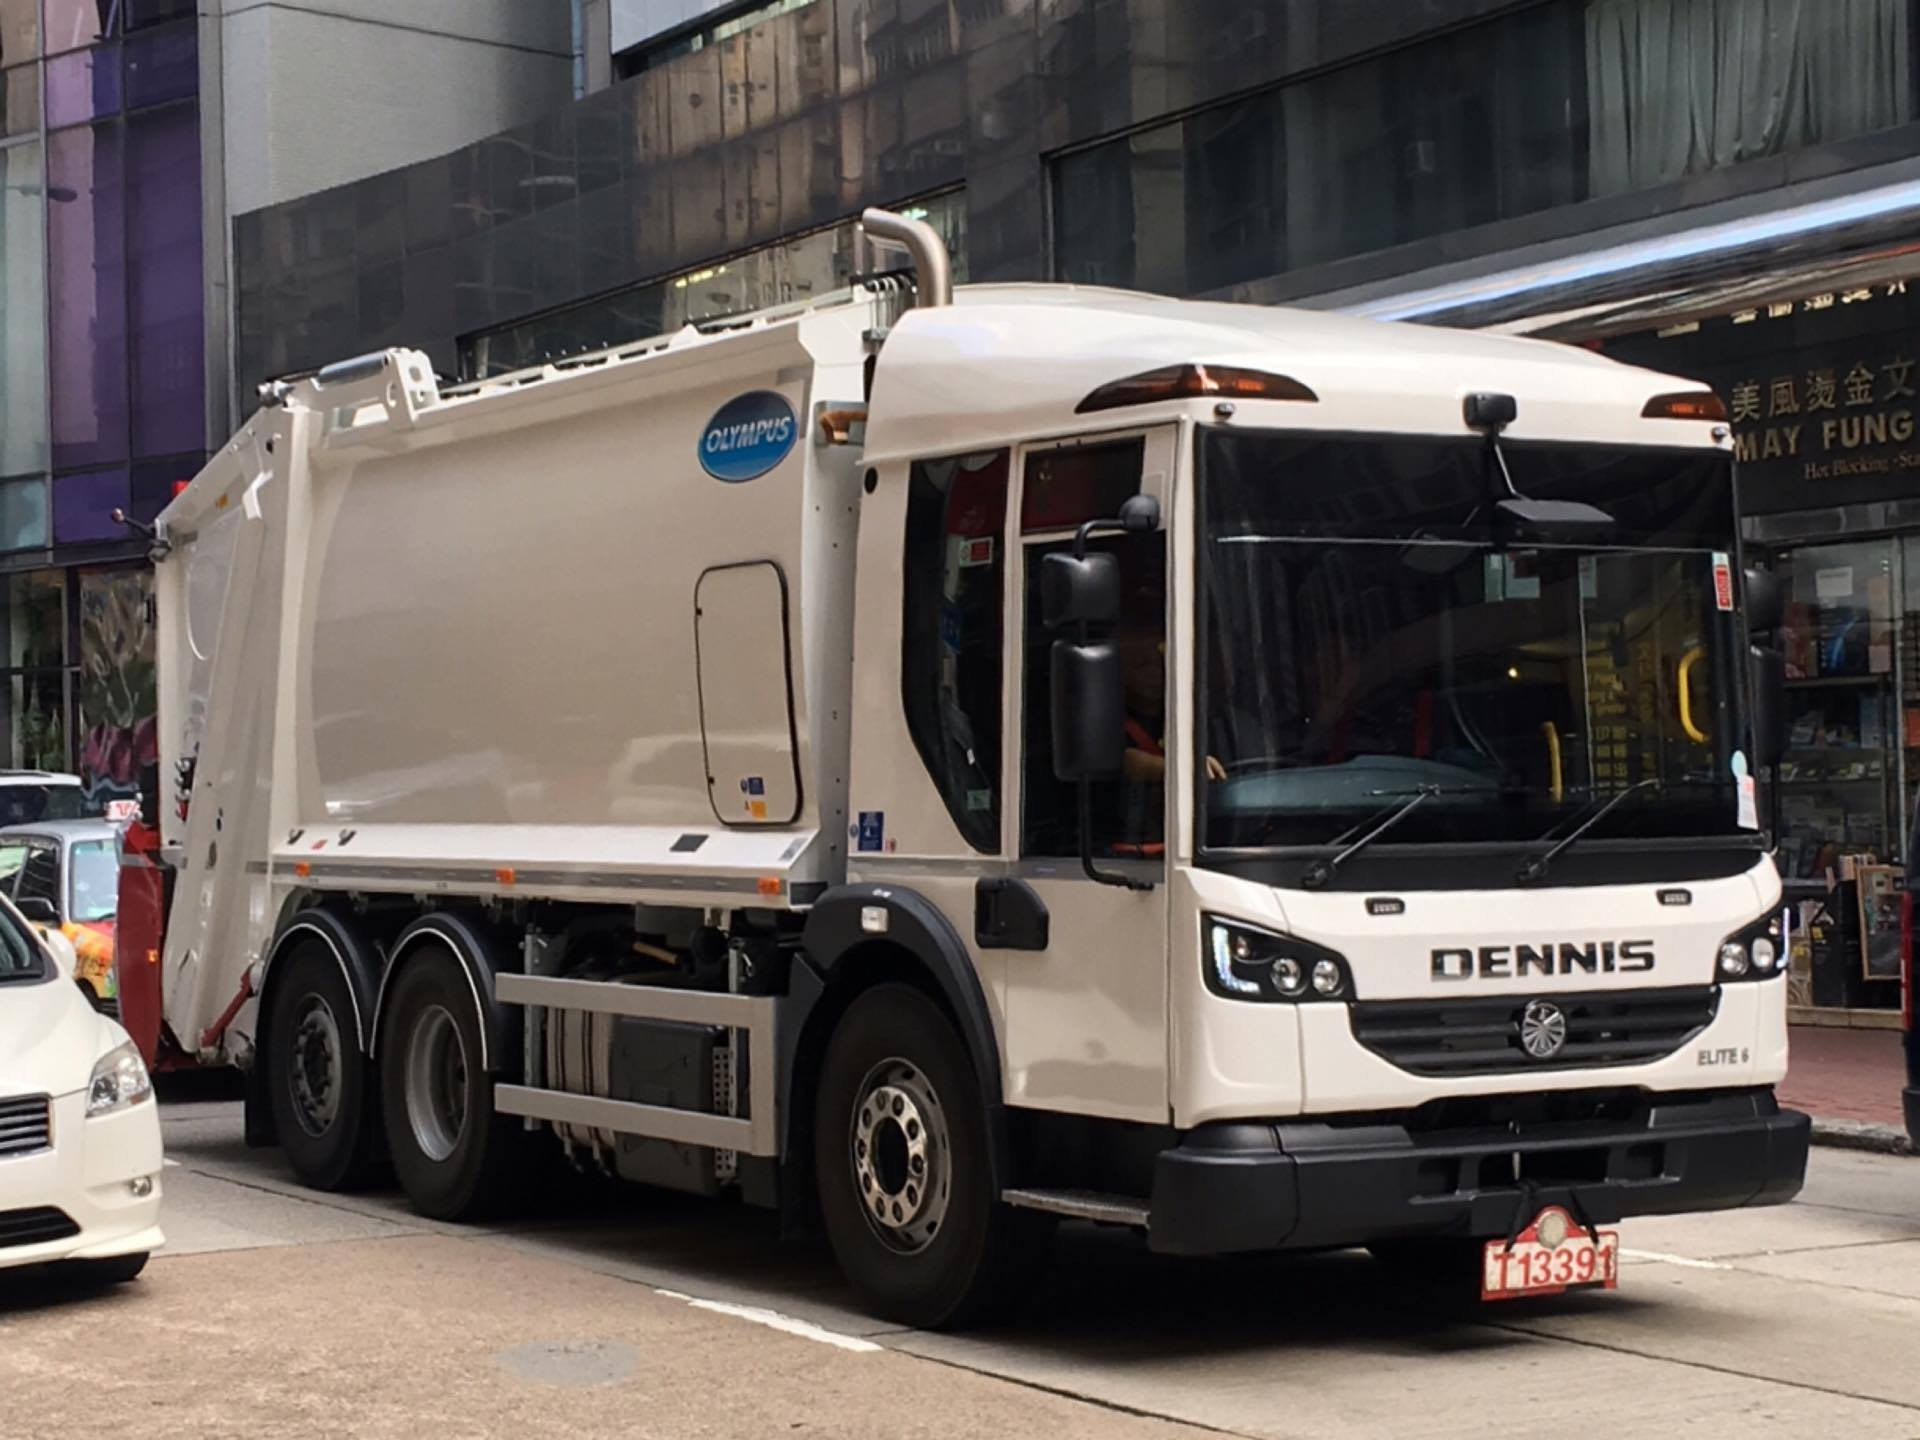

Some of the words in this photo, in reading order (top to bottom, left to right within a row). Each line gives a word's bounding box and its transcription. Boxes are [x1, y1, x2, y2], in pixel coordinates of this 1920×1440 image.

[706, 416, 791, 453] OLYMPUS
[1735, 425, 1801, 463] MAY
[1822, 410, 1914, 450] FUNG
[1431, 940, 1655, 981] DENNIS
[1697, 1047, 1738, 1066] ELITE
[1741, 1047, 1750, 1063] 6
[1493, 1245, 1613, 1291] T13391
